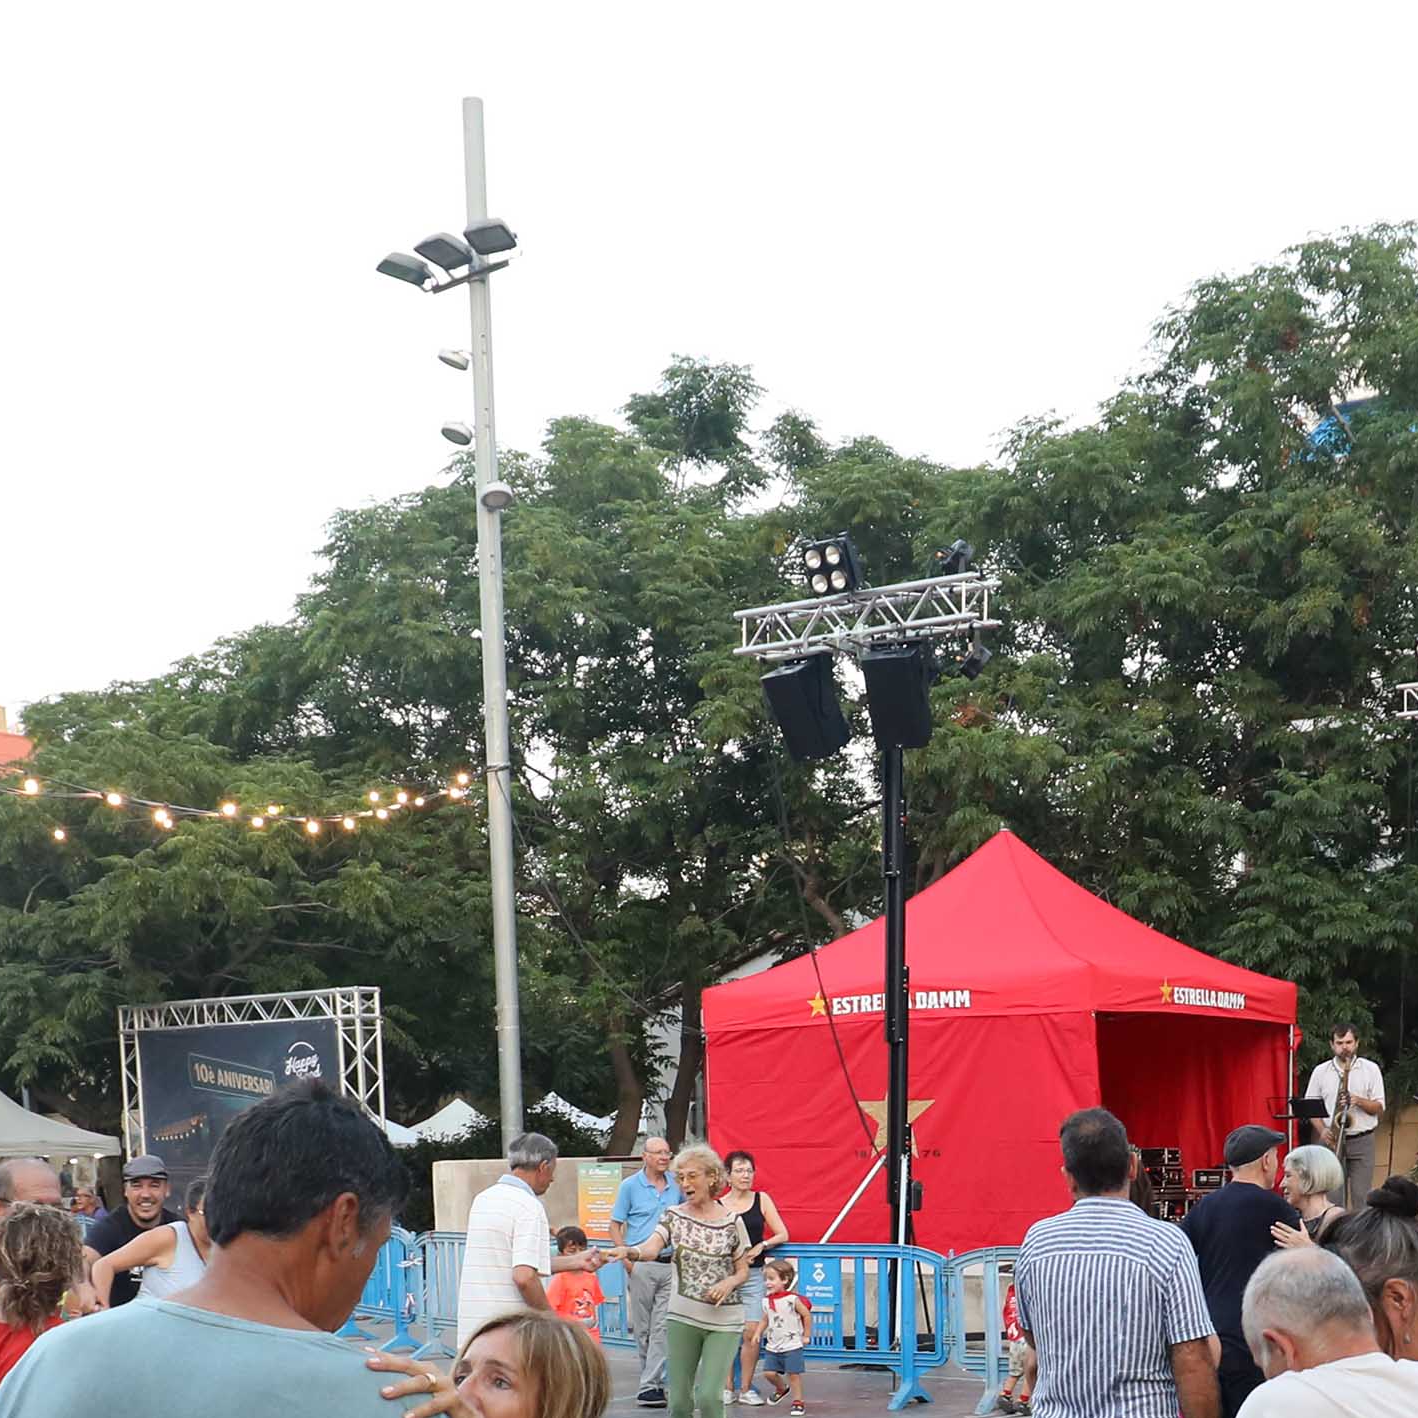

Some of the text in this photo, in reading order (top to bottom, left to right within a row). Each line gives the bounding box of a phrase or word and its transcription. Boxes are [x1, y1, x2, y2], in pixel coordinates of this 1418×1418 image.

[832, 990, 971, 1015] ESTRE DAMM
[1174, 987, 1246, 1009] ESTRELLA DAMM
[285, 1054, 319, 1075] Happy
